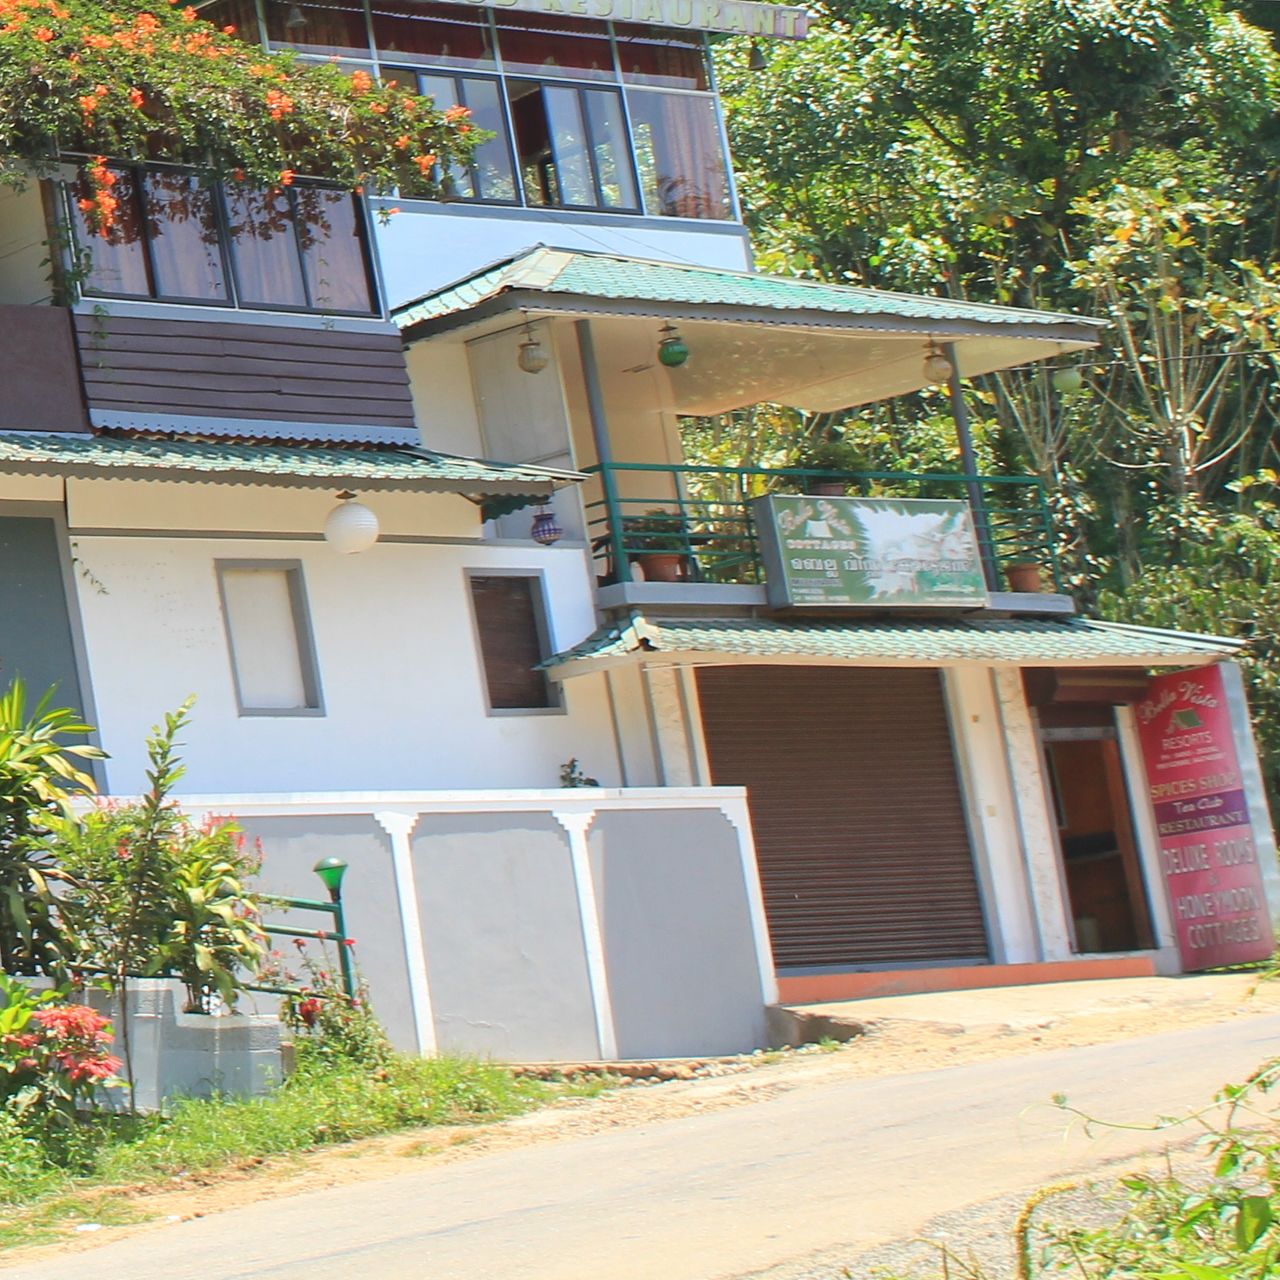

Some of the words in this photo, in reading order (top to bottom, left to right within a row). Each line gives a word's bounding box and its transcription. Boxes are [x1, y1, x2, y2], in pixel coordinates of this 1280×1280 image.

[1139, 688, 1177, 725] Bella
[1178, 681, 1218, 709] Vista
[1162, 730, 1213, 751] RESORTS
[1151, 779, 1197, 798] SPICES
[1199, 772, 1238, 790] SHOP
[1159, 810, 1244, 834] RESTAURANT
[1161, 844, 1211, 875] DELUXE
[1214, 837, 1254, 867] ROOMS
[1178, 887, 1261, 919] HONEYMOON
[1189, 917, 1262, 949] COTTAGES
